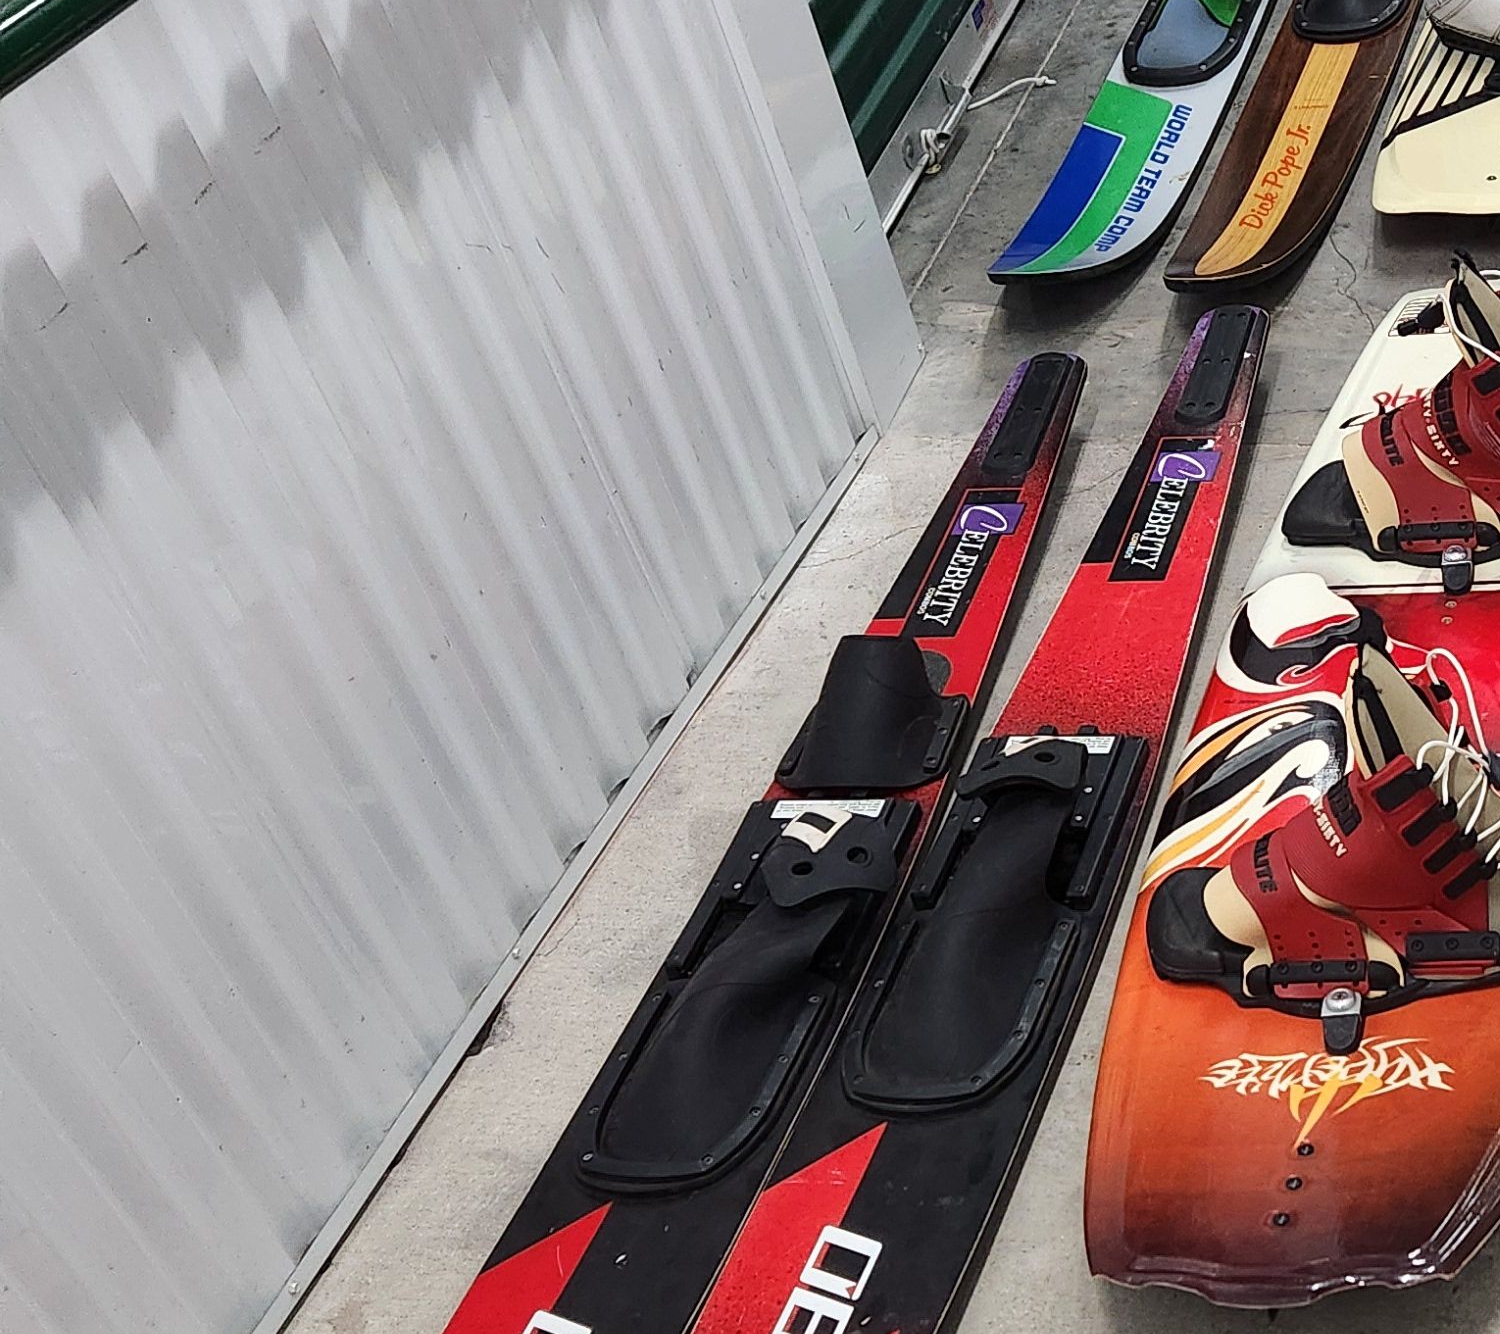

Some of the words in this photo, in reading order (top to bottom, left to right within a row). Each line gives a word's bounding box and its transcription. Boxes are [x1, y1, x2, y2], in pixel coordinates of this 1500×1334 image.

[1150, 104, 1193, 165] WORLD
[1238, 192, 1279, 229] Dick
[1261, 145, 1303, 189] Pope
[1286, 123, 1311, 146] Jr.
[1094, 215, 1135, 252] COMP
[1131, 452, 1206, 571] CELEBRITY
[922, 505, 1008, 627] CELEBRITY
